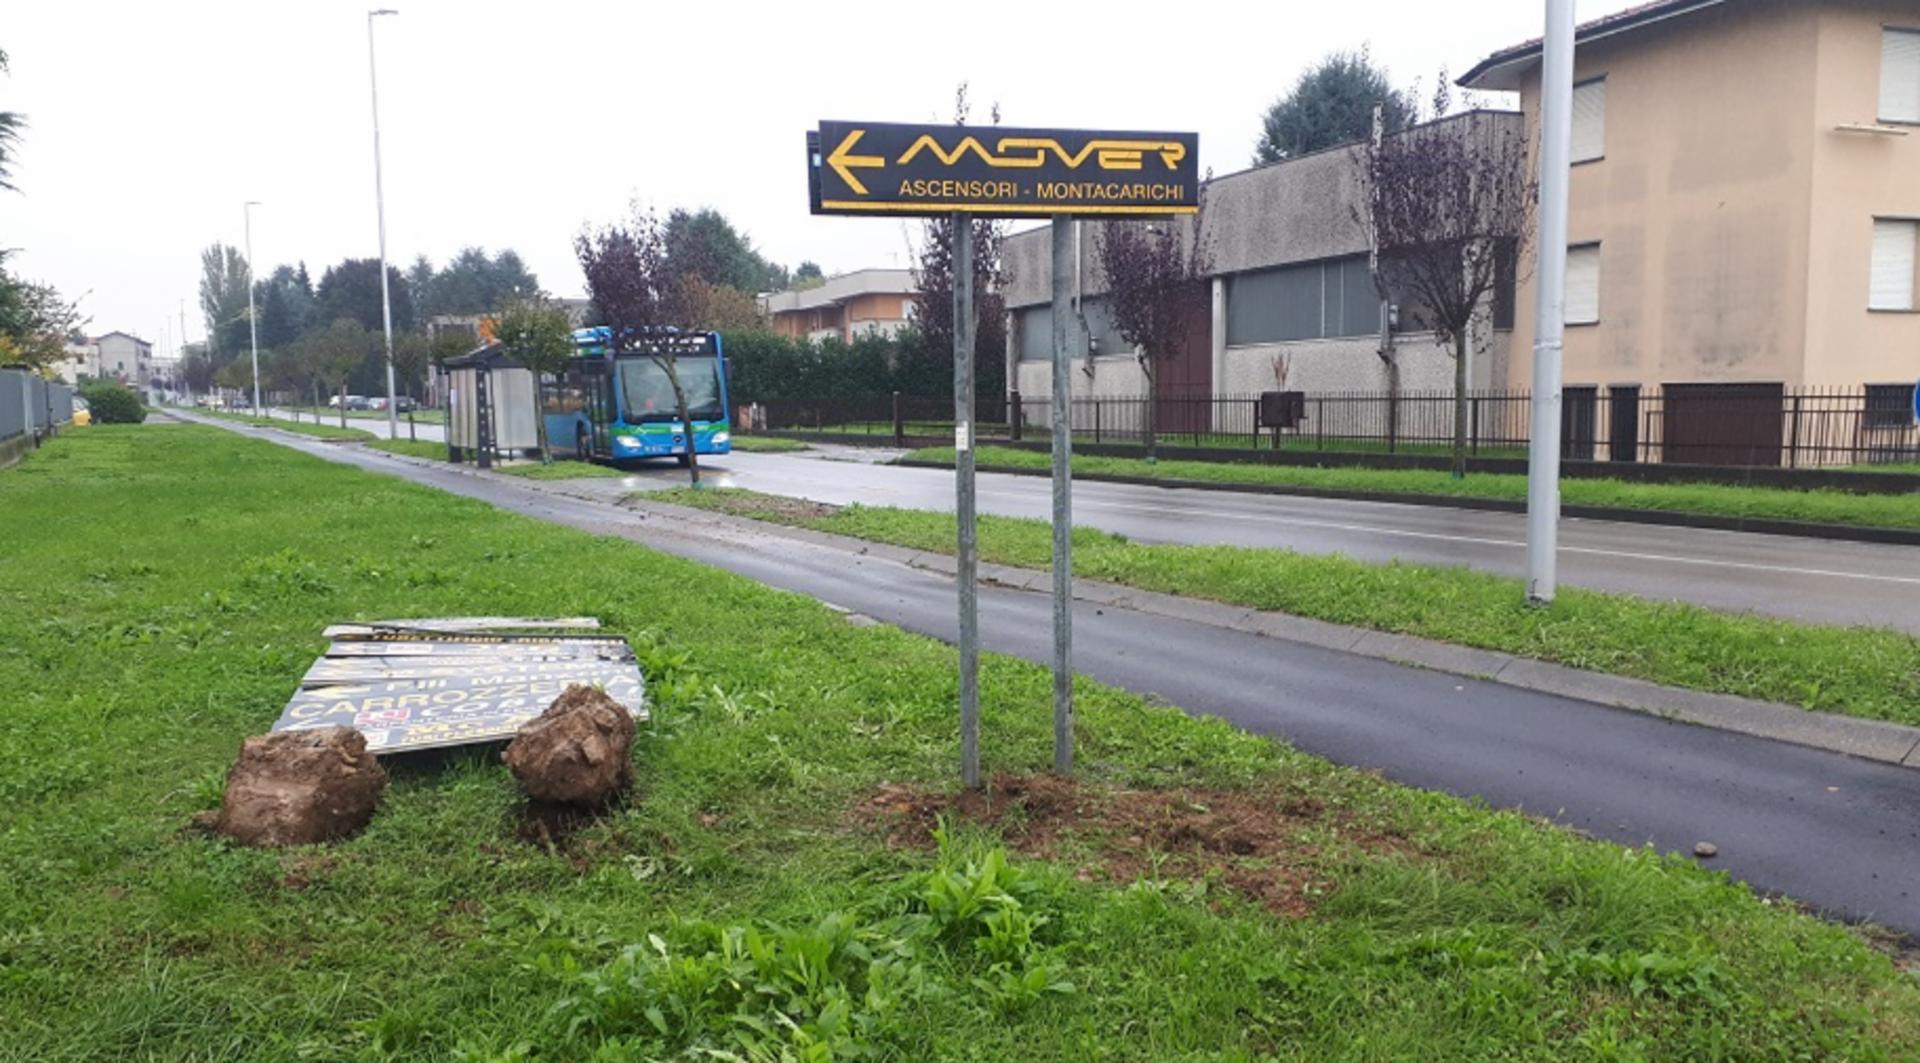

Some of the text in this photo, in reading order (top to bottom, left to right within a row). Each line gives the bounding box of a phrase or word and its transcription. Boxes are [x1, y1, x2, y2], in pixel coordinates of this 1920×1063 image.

[897, 134, 1186, 170] MOVER
[898, 179, 1018, 199] ASCENSORI
[1037, 182, 1184, 201] MONTACARICHI
